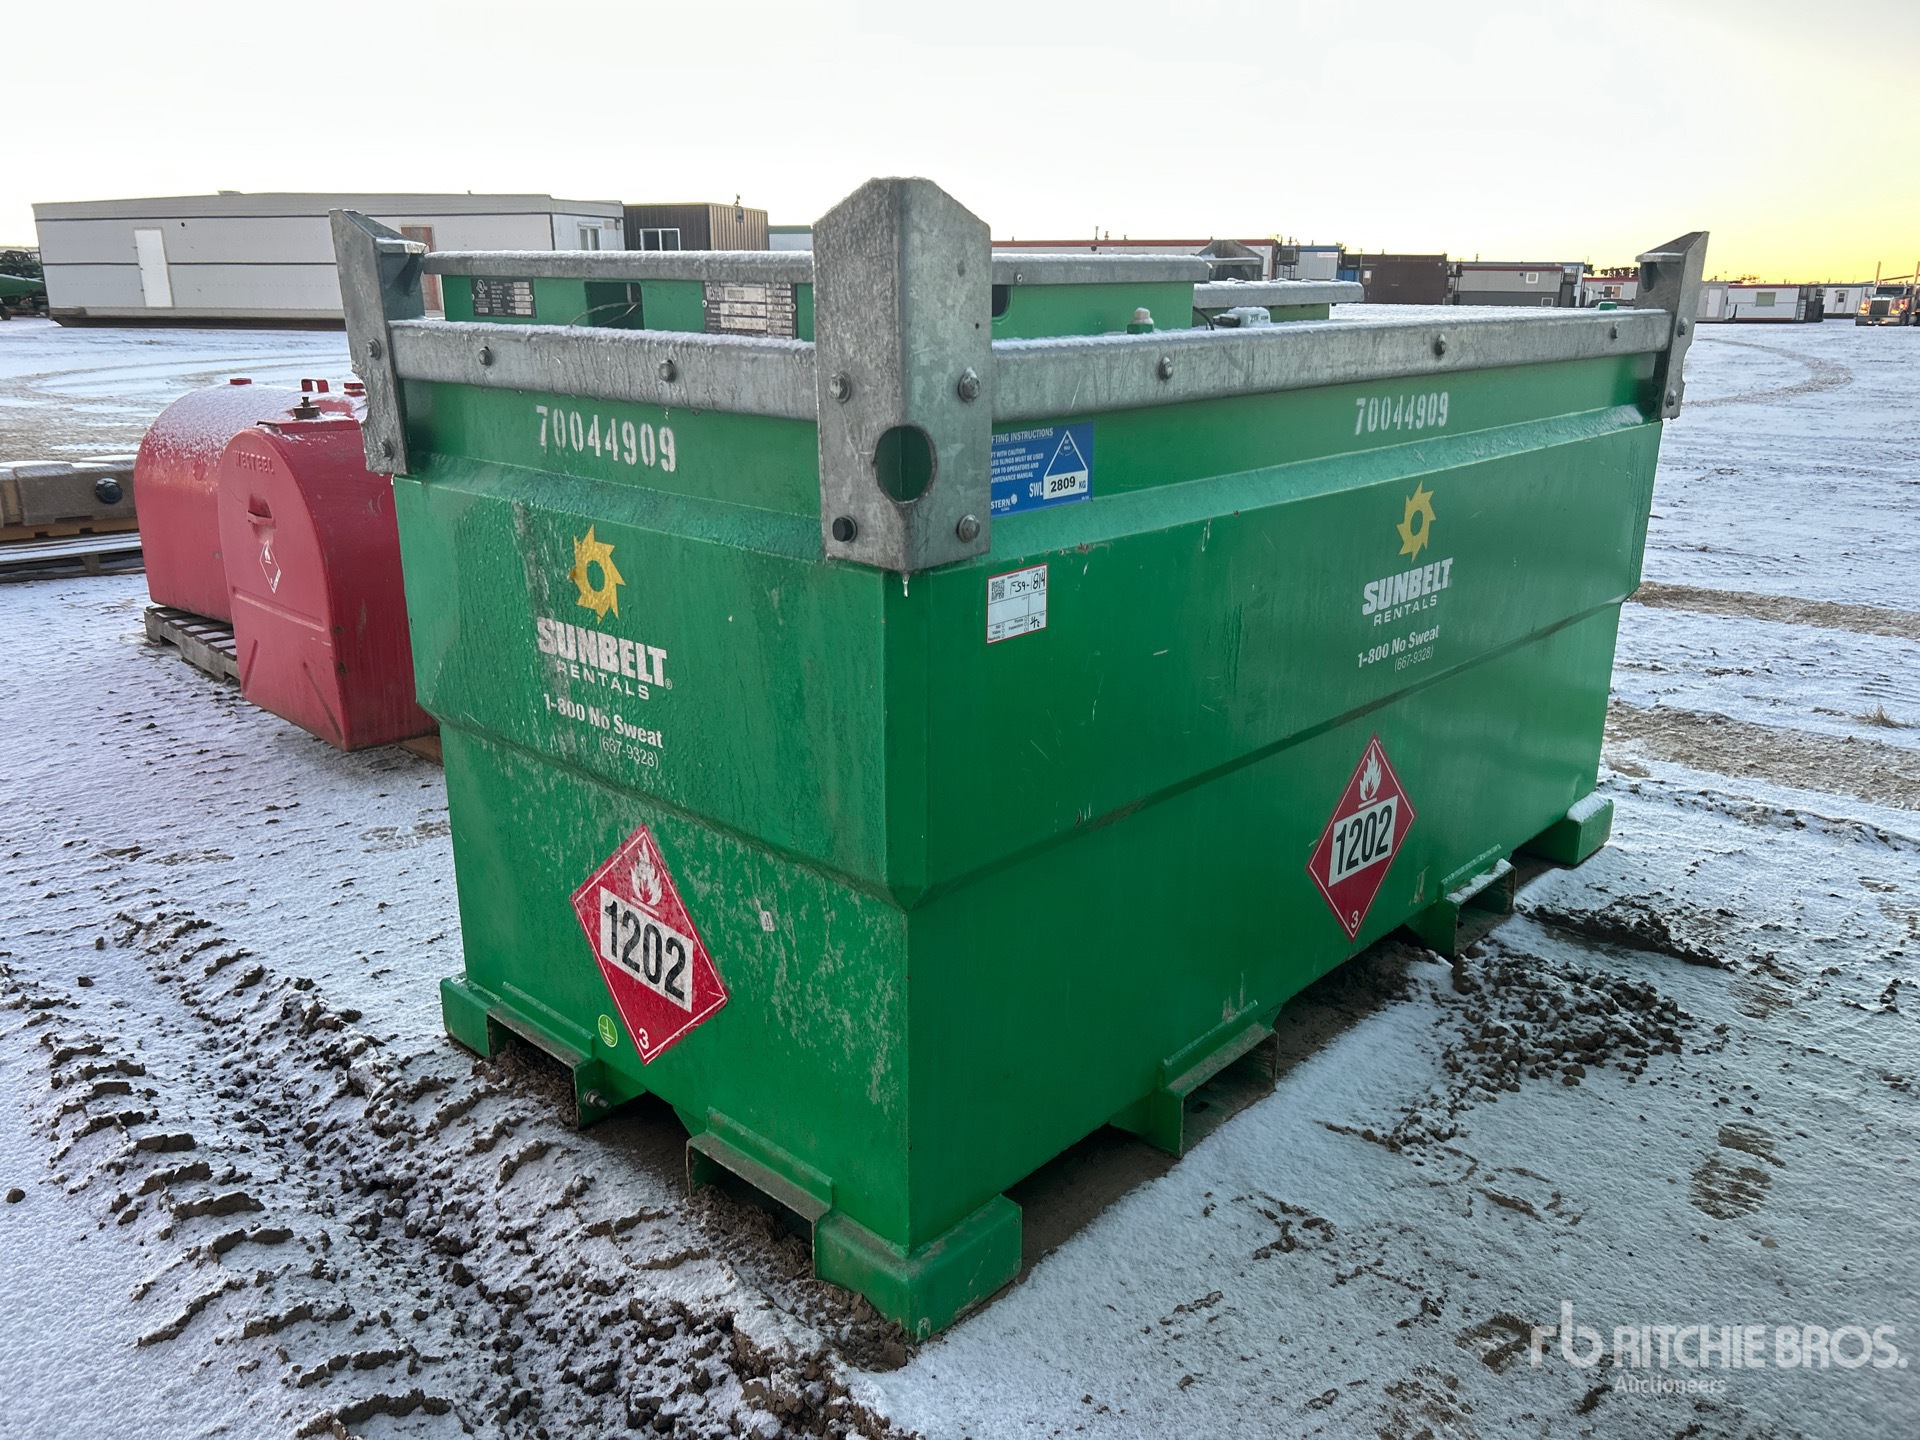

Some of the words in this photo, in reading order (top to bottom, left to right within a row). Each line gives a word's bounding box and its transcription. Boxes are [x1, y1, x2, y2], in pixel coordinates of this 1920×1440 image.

[1355, 391, 1449, 435] 70044909
[536, 405, 676, 472] 70044909
[992, 433, 1009, 444] FTING
[1010, 427, 1053, 442] INSTRUCTIONS
[1008, 447, 1026, 456] CAUTION
[991, 473, 1016, 484] AINTENANCE
[1017, 471, 1034, 480] MANUAL
[1029, 481, 1043, 498] SWL
[1050, 476, 1076, 493] 2809
[1078, 480, 1087, 490] KG
[990, 498, 1011, 510] STERN
[1362, 557, 1453, 615] SUNBELT
[1373, 594, 1438, 627] RENTALS
[537, 616, 667, 687] SUNBELT
[1357, 642, 1390, 668] 1-800
[1391, 637, 1406, 656] No
[1408, 624, 1440, 649] Sweat
[1394, 644, 1434, 674] (667-9328)
[556, 660, 650, 700] RENTALS
[543, 693, 586, 722] 1-800
[589, 706, 611, 730] No
[613, 714, 664, 749] Sweat
[1335, 804, 1393, 876] 1202
[1350, 909, 1360, 929] 3
[604, 900, 686, 1002] 1202
[638, 1027, 650, 1050] 3
